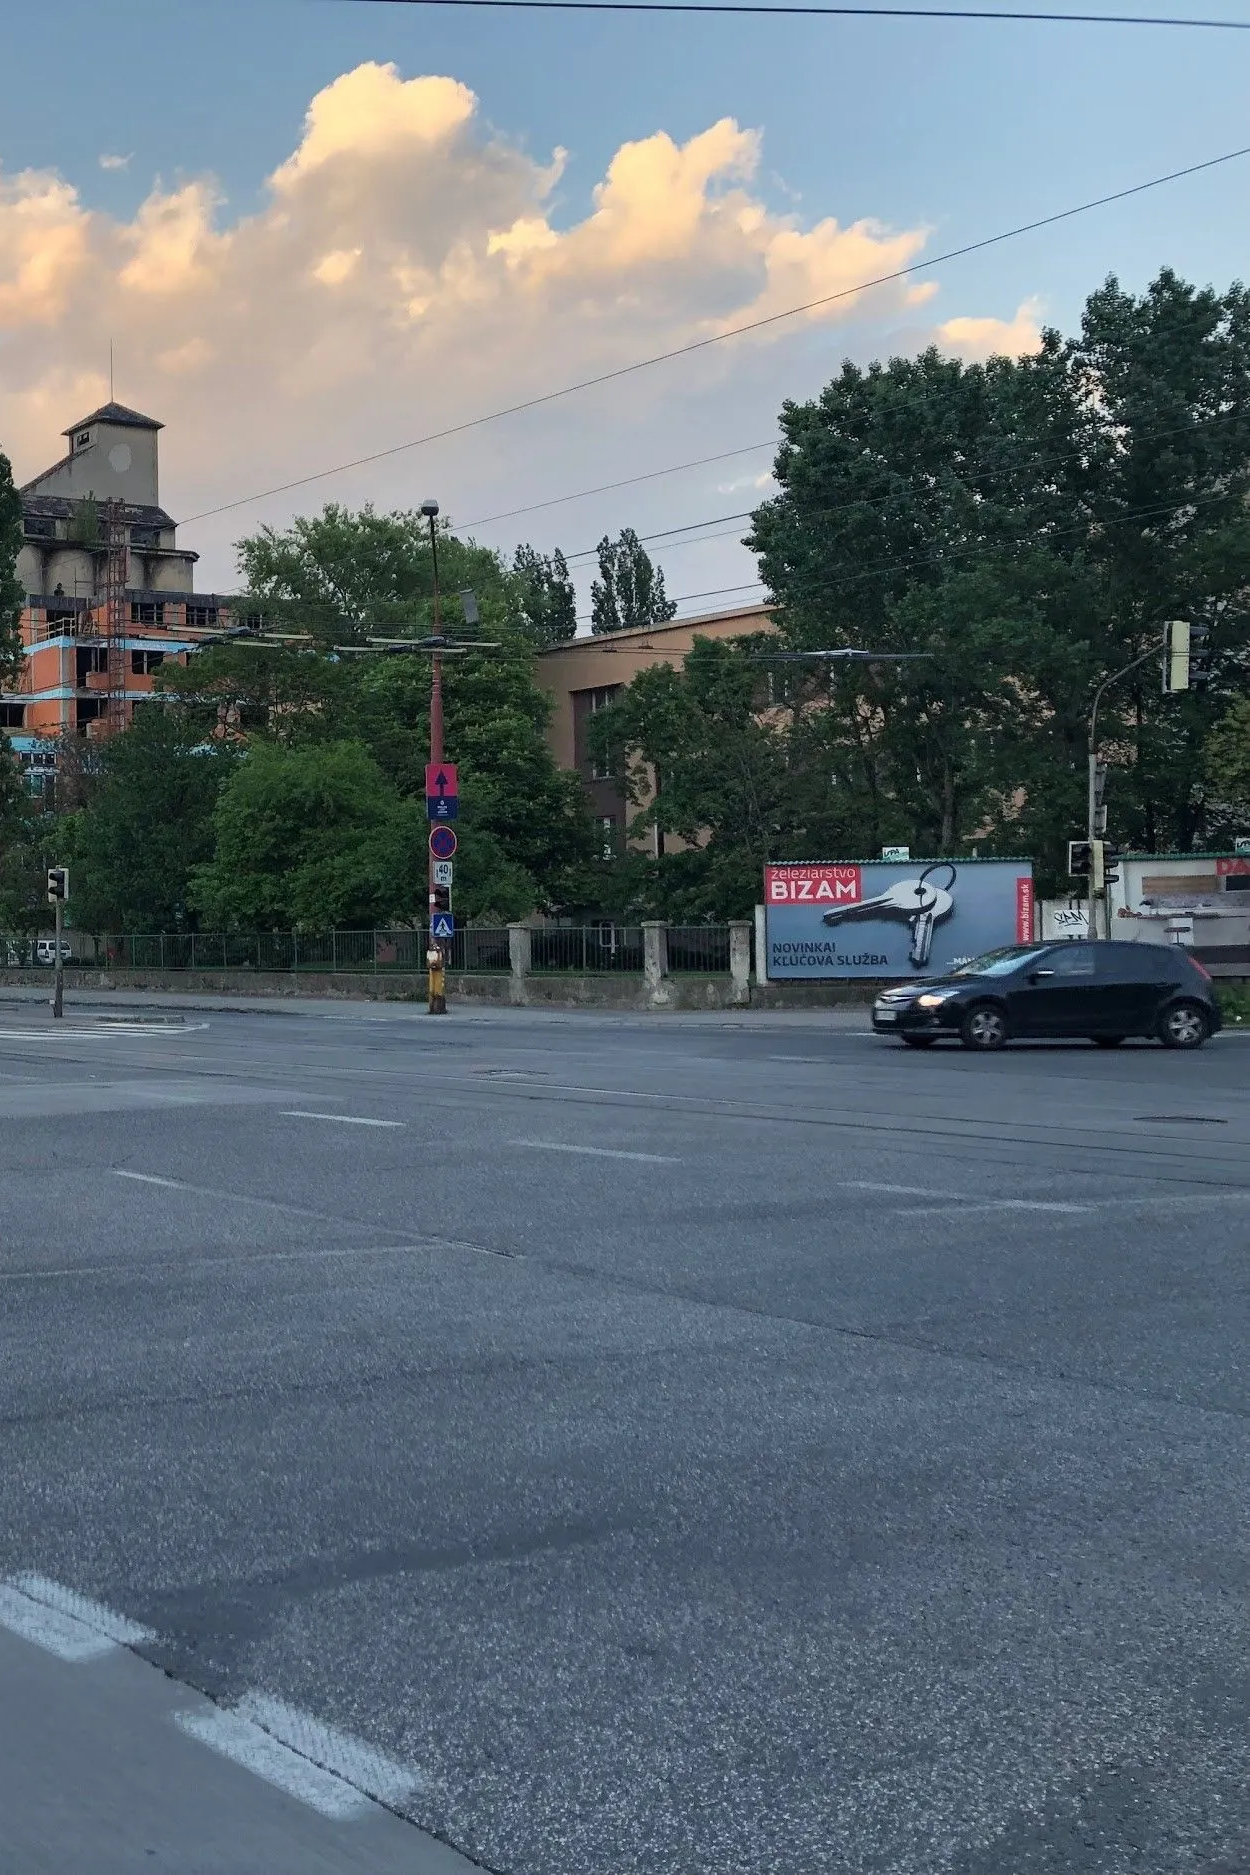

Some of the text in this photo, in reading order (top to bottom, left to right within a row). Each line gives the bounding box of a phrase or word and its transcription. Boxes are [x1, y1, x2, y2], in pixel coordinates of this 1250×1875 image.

[438, 864, 449, 875] 40
[771, 867, 856, 879] železiarstvo
[771, 880, 856, 899] BIZAM
[1021, 883, 1030, 941] www.bizam.sk
[837, 952, 889, 965] SLUŽBA
